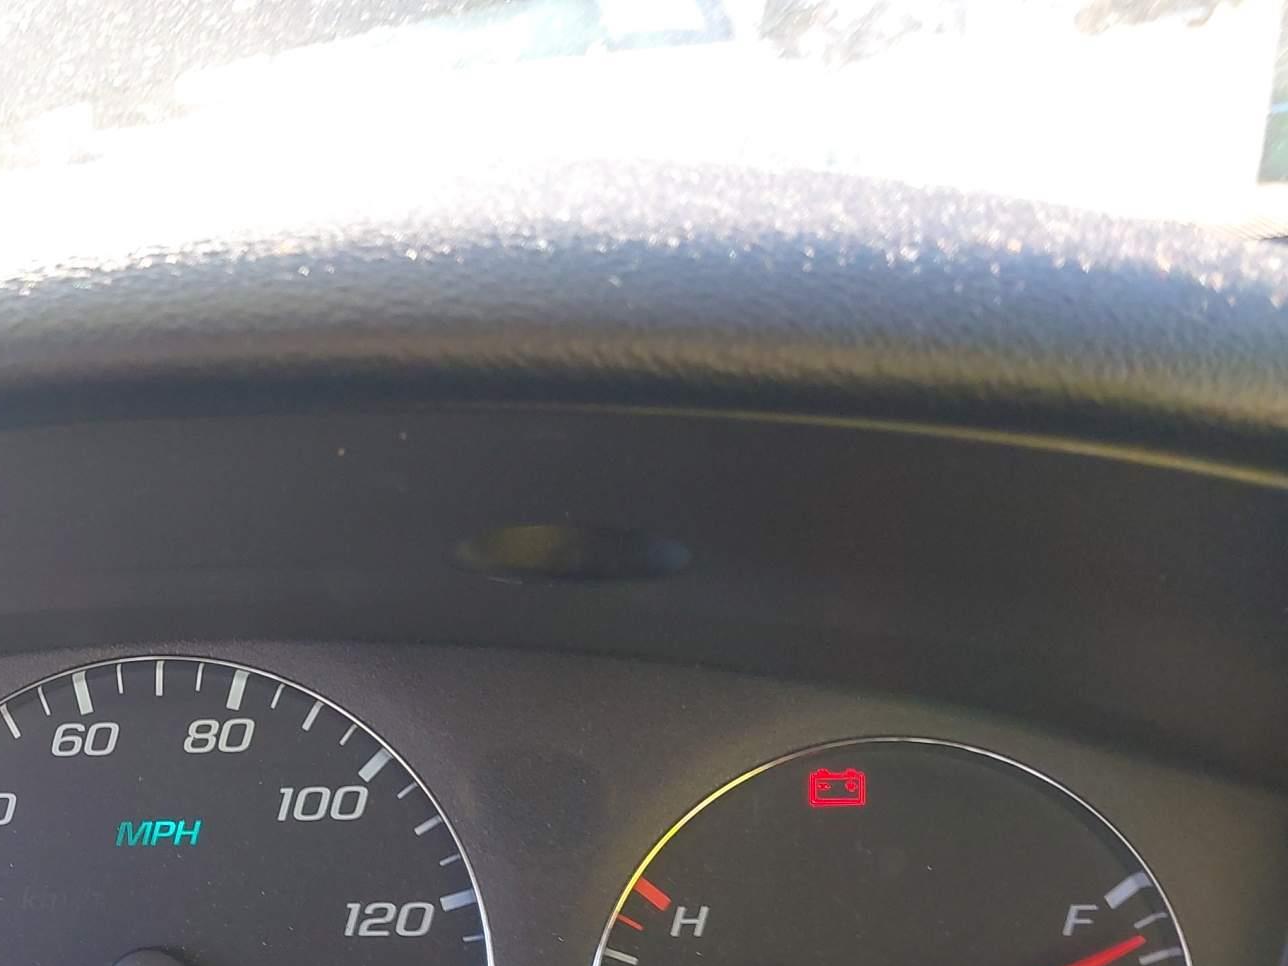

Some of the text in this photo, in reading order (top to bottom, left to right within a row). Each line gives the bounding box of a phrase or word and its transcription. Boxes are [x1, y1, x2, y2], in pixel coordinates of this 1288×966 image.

[51, 722, 120, 756] 60
[183, 718, 256, 754] 80
[276, 786, 369, 822] 100
[115, 819, 202, 848] MPH
[343, 902, 435, 937] 120
[669, 906, 710, 937] H
[1062, 904, 1099, 936] F
